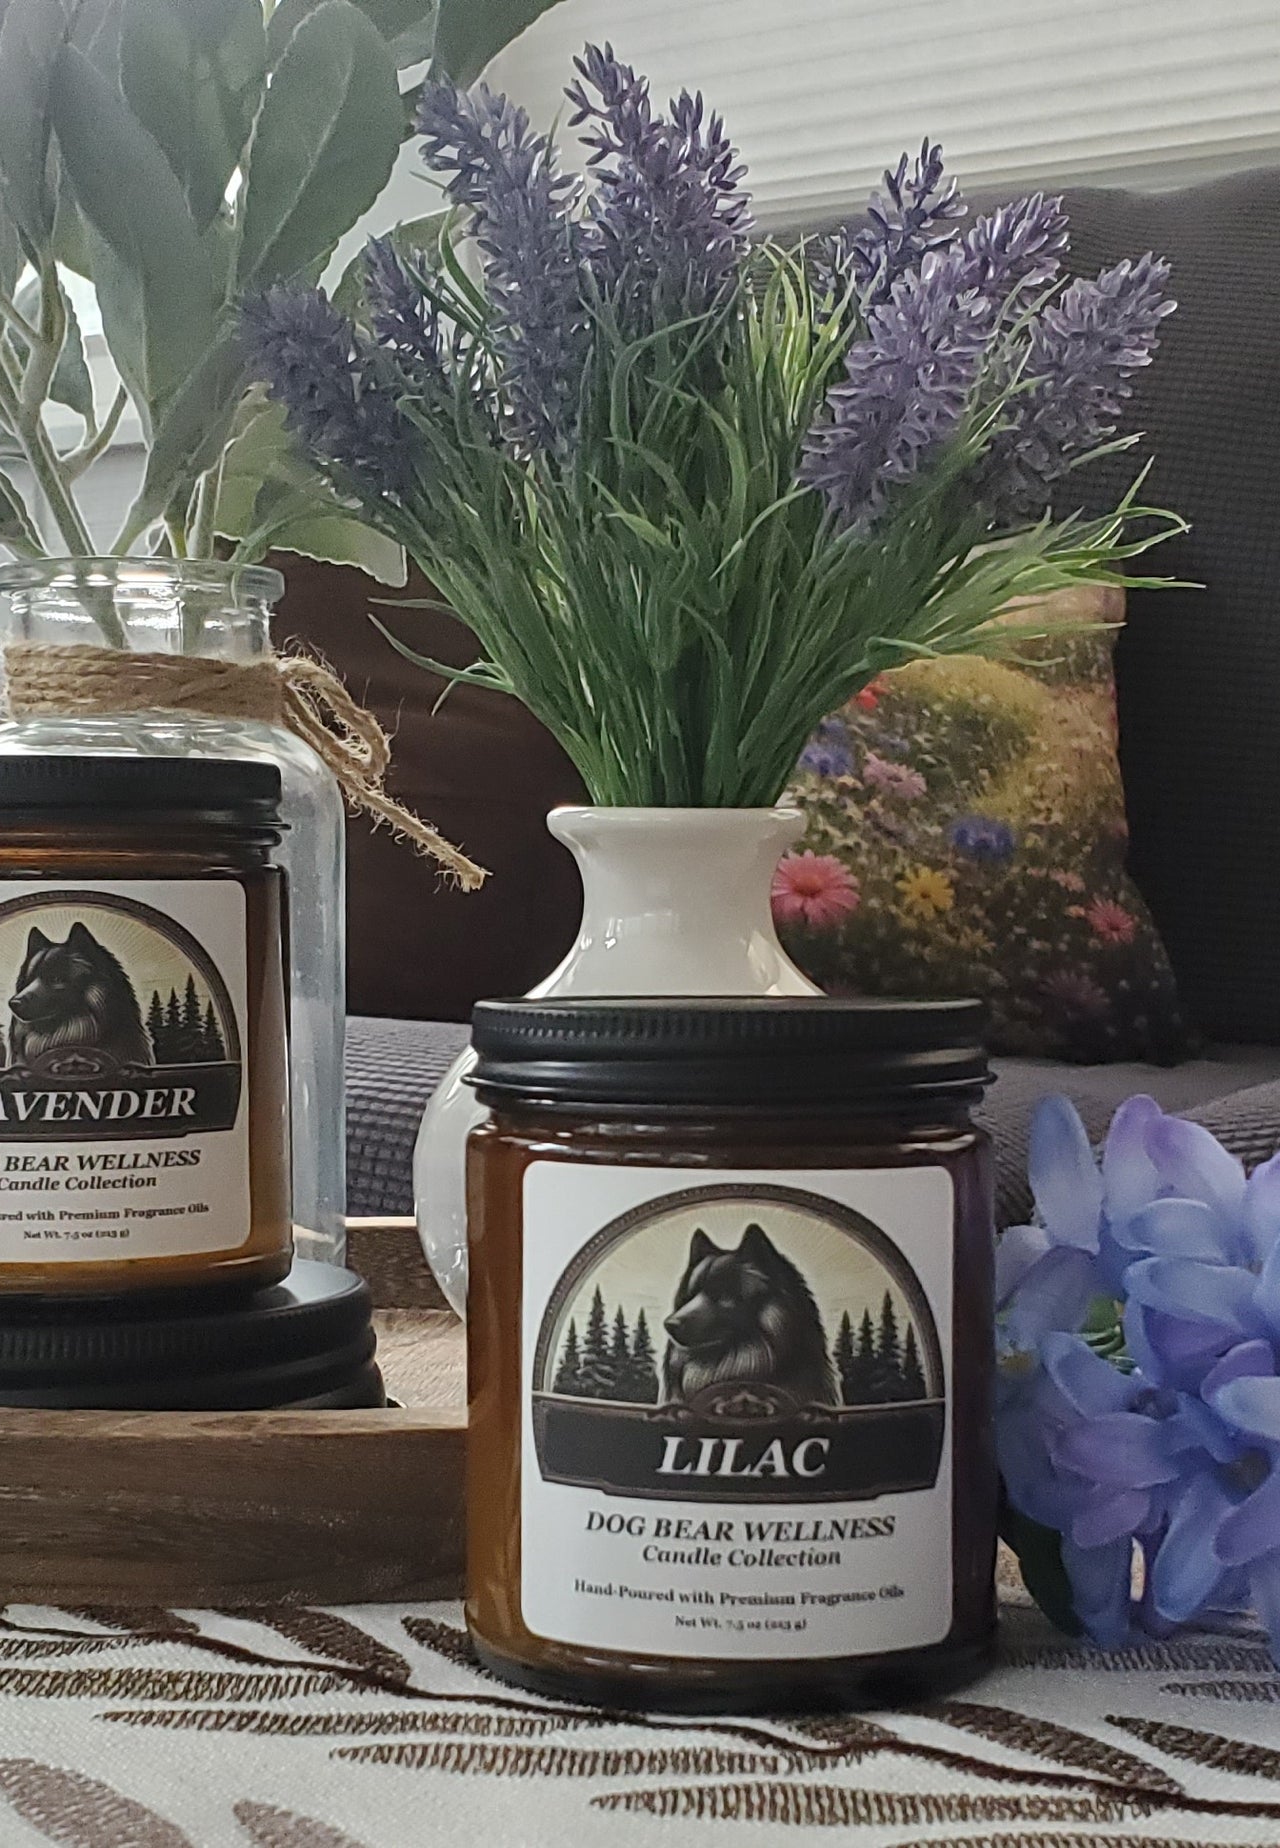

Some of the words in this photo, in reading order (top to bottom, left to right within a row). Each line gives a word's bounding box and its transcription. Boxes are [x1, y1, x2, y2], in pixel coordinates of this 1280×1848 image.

[4, 1154, 70, 1172] BEAR
[76, 1149, 202, 1171] WELLNESS
[65, 1174, 157, 1191] Collection
[26, 1210, 55, 1221] with
[58, 1209, 120, 1221] Premium
[124, 1206, 186, 1219] Fragrance
[188, 1203, 209, 1214] Oils
[23, 1230, 41, 1239] Net
[63, 1231, 80, 1240] 7.5
[656, 1435, 830, 1478] LILAC
[586, 1510, 646, 1537] DOG
[653, 1516, 734, 1542] BEAR
[744, 1515, 896, 1542] WELLNESS
[642, 1544, 722, 1567] Candle
[727, 1547, 842, 1567] Collection
[573, 1579, 675, 1602] Hand-Poured
[678, 1591, 715, 1605] with
[719, 1591, 795, 1606] Premium
[800, 1589, 876, 1607] Fragrance
[878, 1584, 905, 1599] Oils
[675, 1615, 696, 1628] Net
